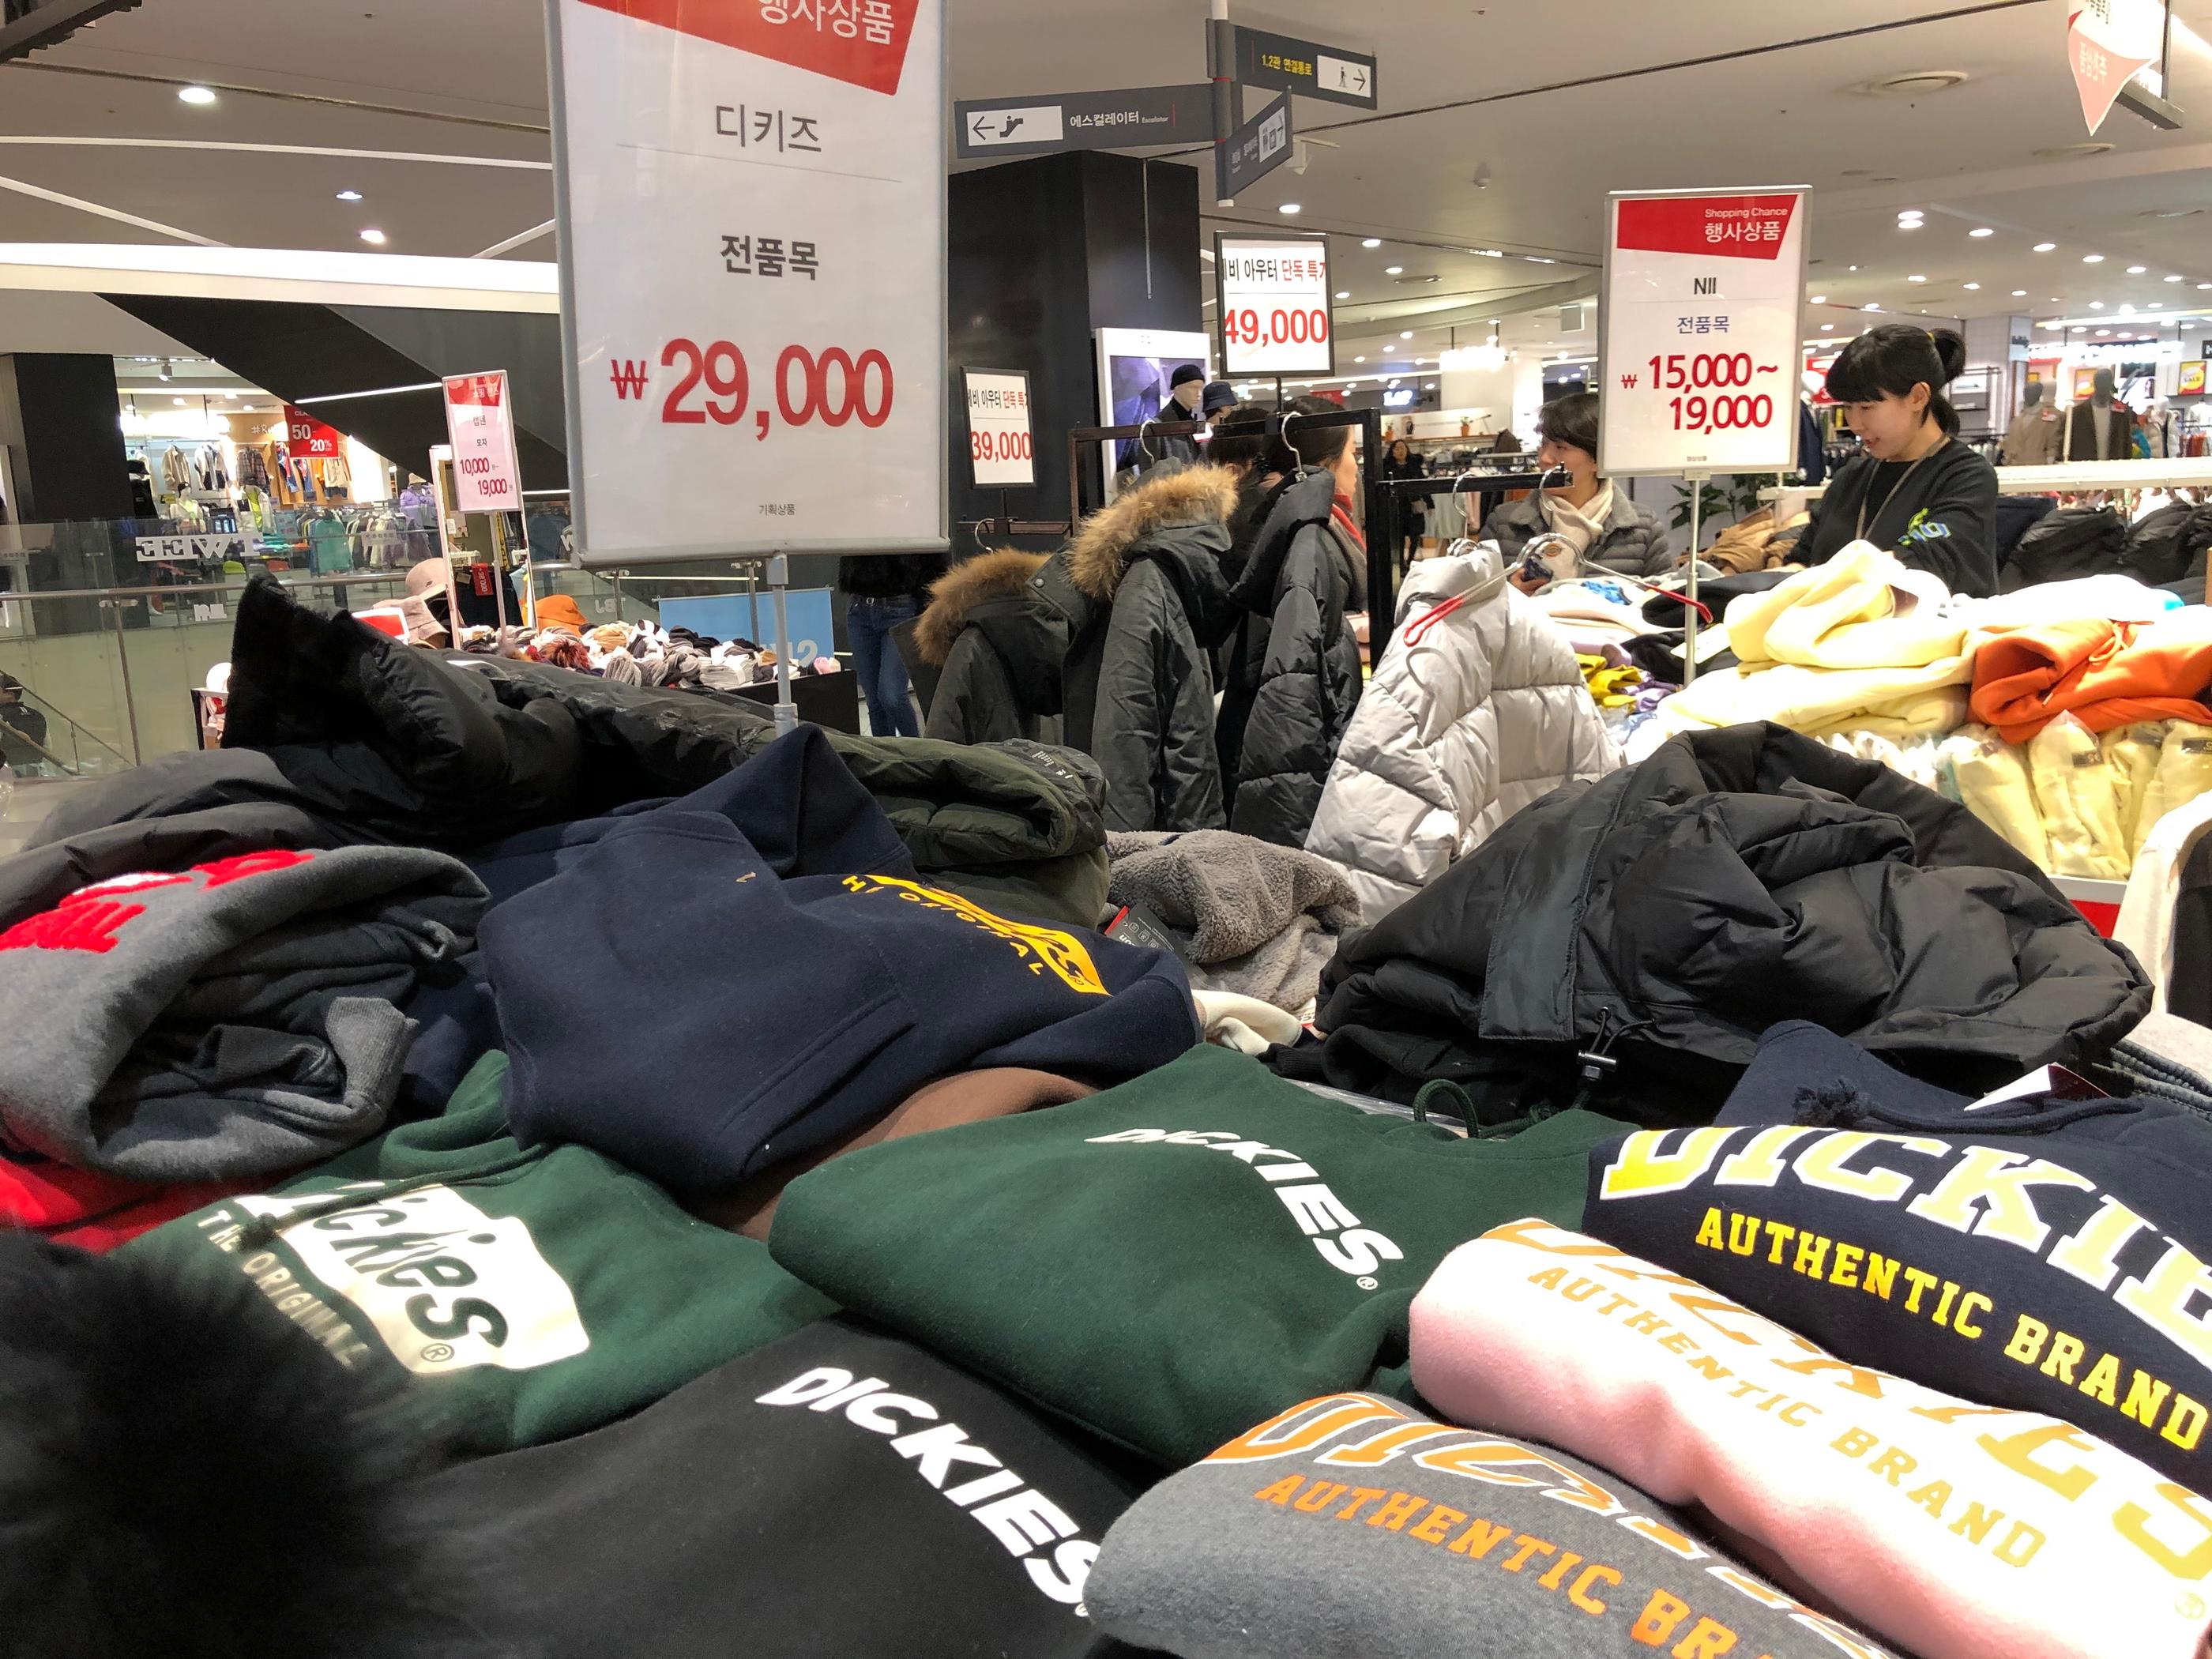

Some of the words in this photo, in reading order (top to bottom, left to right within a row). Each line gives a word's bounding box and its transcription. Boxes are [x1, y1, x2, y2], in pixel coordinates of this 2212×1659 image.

[715, 103, 822, 152] 디키즈
[1070, 111, 1139, 128] 에스컬레이터
[1705, 208, 1749, 219] Shopping
[1751, 206, 1788, 216] Chance
[1704, 221, 1781, 243] 행사상품
[720, 235, 819, 280] 전품목
[1243, 258, 1277, 281] 아우터
[1281, 259, 1304, 282] 단독
[1224, 309, 1328, 347] 49,000
[1676, 315, 1730, 334] 전품목
[981, 389, 1002, 409] 아우터
[1003, 389, 1017, 409] 단독
[1669, 394, 1773, 434] 19,000
[476, 438, 487, 447] 모자
[971, 431, 1033, 464] 39,000
[460, 457, 490, 476] 10,000
[477, 478, 507, 498] 19,000
[758, 503, 796, 517] 기획상품
[1083, 1128, 1405, 1275] DICKIES
[1695, 1207, 1994, 1340] AUTHENTIC
[2003, 1313, 2211, 1451] BRAND
[1527, 1266, 1823, 1428] AUTHENTIC
[1830, 1427, 2047, 1569] BRAND
[755, 1367, 1101, 1604] DICKIES
[1254, 1473, 1623, 1616] AUTHENTIC
